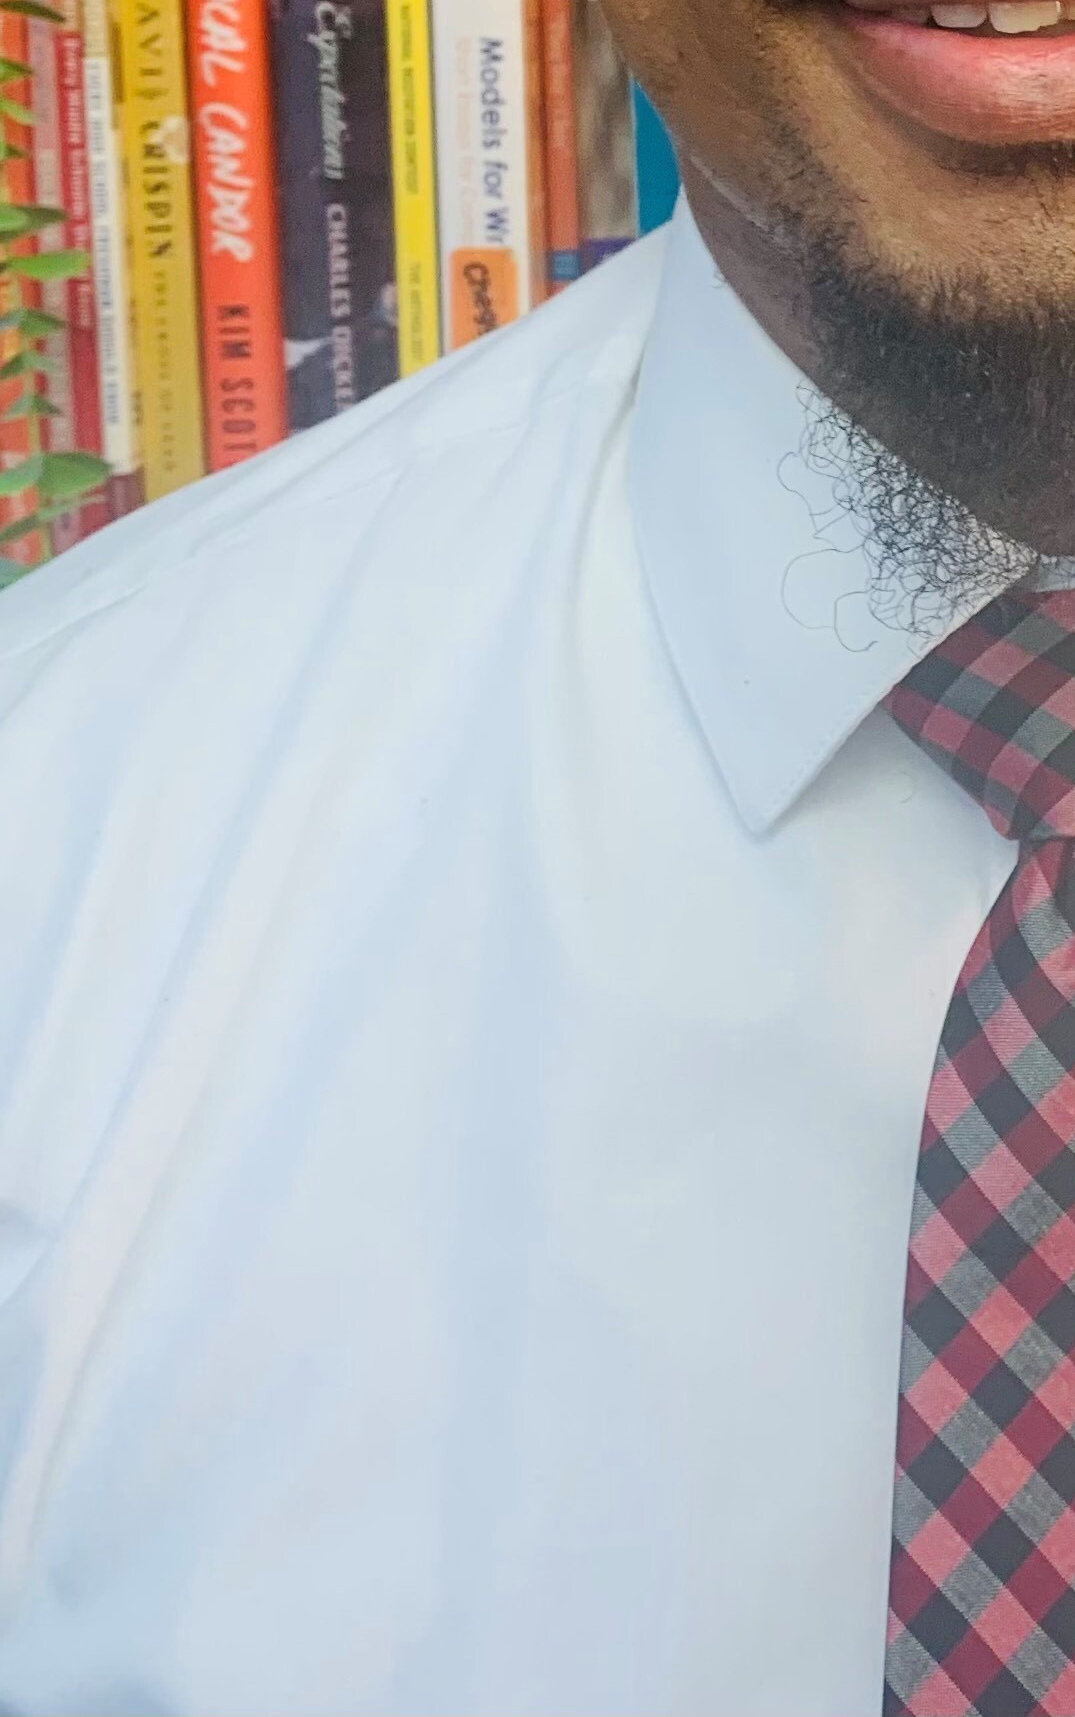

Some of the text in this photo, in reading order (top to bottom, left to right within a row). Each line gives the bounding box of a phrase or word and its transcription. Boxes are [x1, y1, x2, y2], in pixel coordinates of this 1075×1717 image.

[479, 37, 509, 149] Models
[199, 101, 256, 263] CANDOR
[482, 160, 510, 198] for
[327, 203, 353, 318] CHARLES
[216, 304, 252, 361] KIM
[221, 377, 258, 455] SCOT
